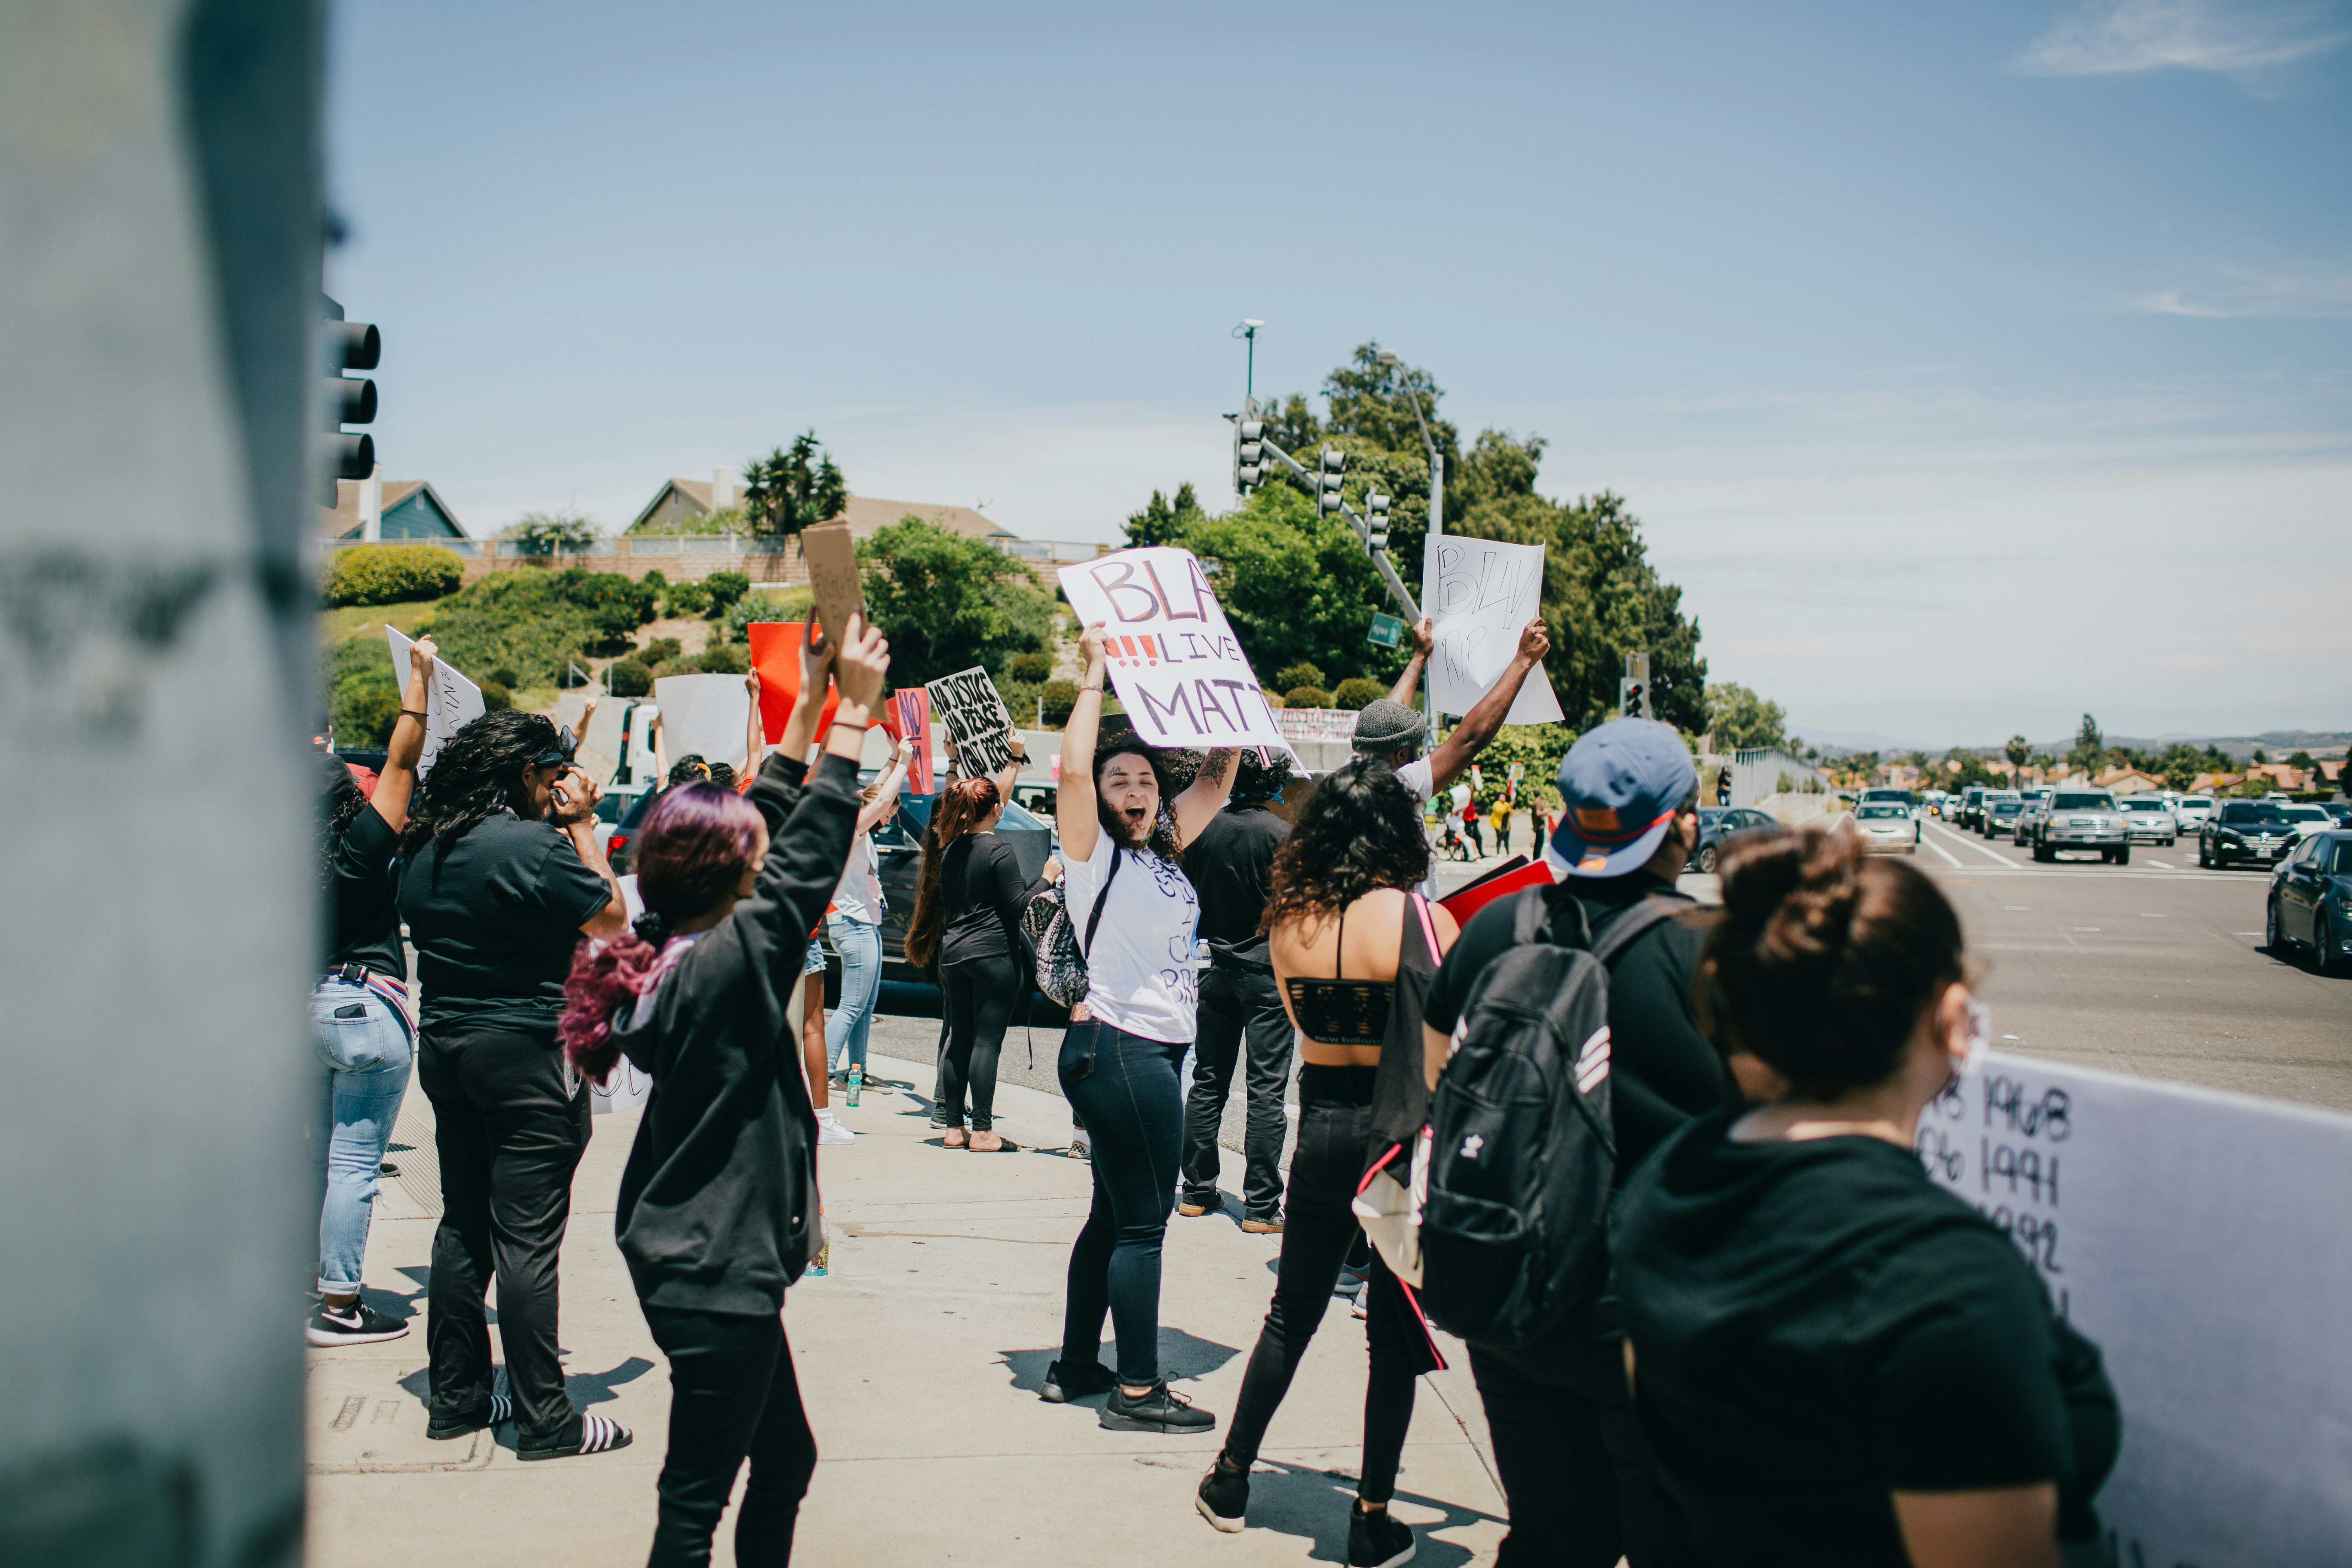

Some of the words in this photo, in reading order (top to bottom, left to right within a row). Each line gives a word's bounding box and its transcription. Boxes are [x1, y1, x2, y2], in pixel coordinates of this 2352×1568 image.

[1089, 558, 1216, 623] BLA
[1442, 626, 1487, 689] RIP
[898, 691, 921, 737] NO
[928, 684, 951, 717] NO
[945, 711, 969, 744] NO
[960, 703, 1005, 737] PEACE
[1983, 1075, 2072, 1142] 1968
[1980, 1135, 2061, 1207] 1991
[1979, 1203, 2063, 1274] 992
